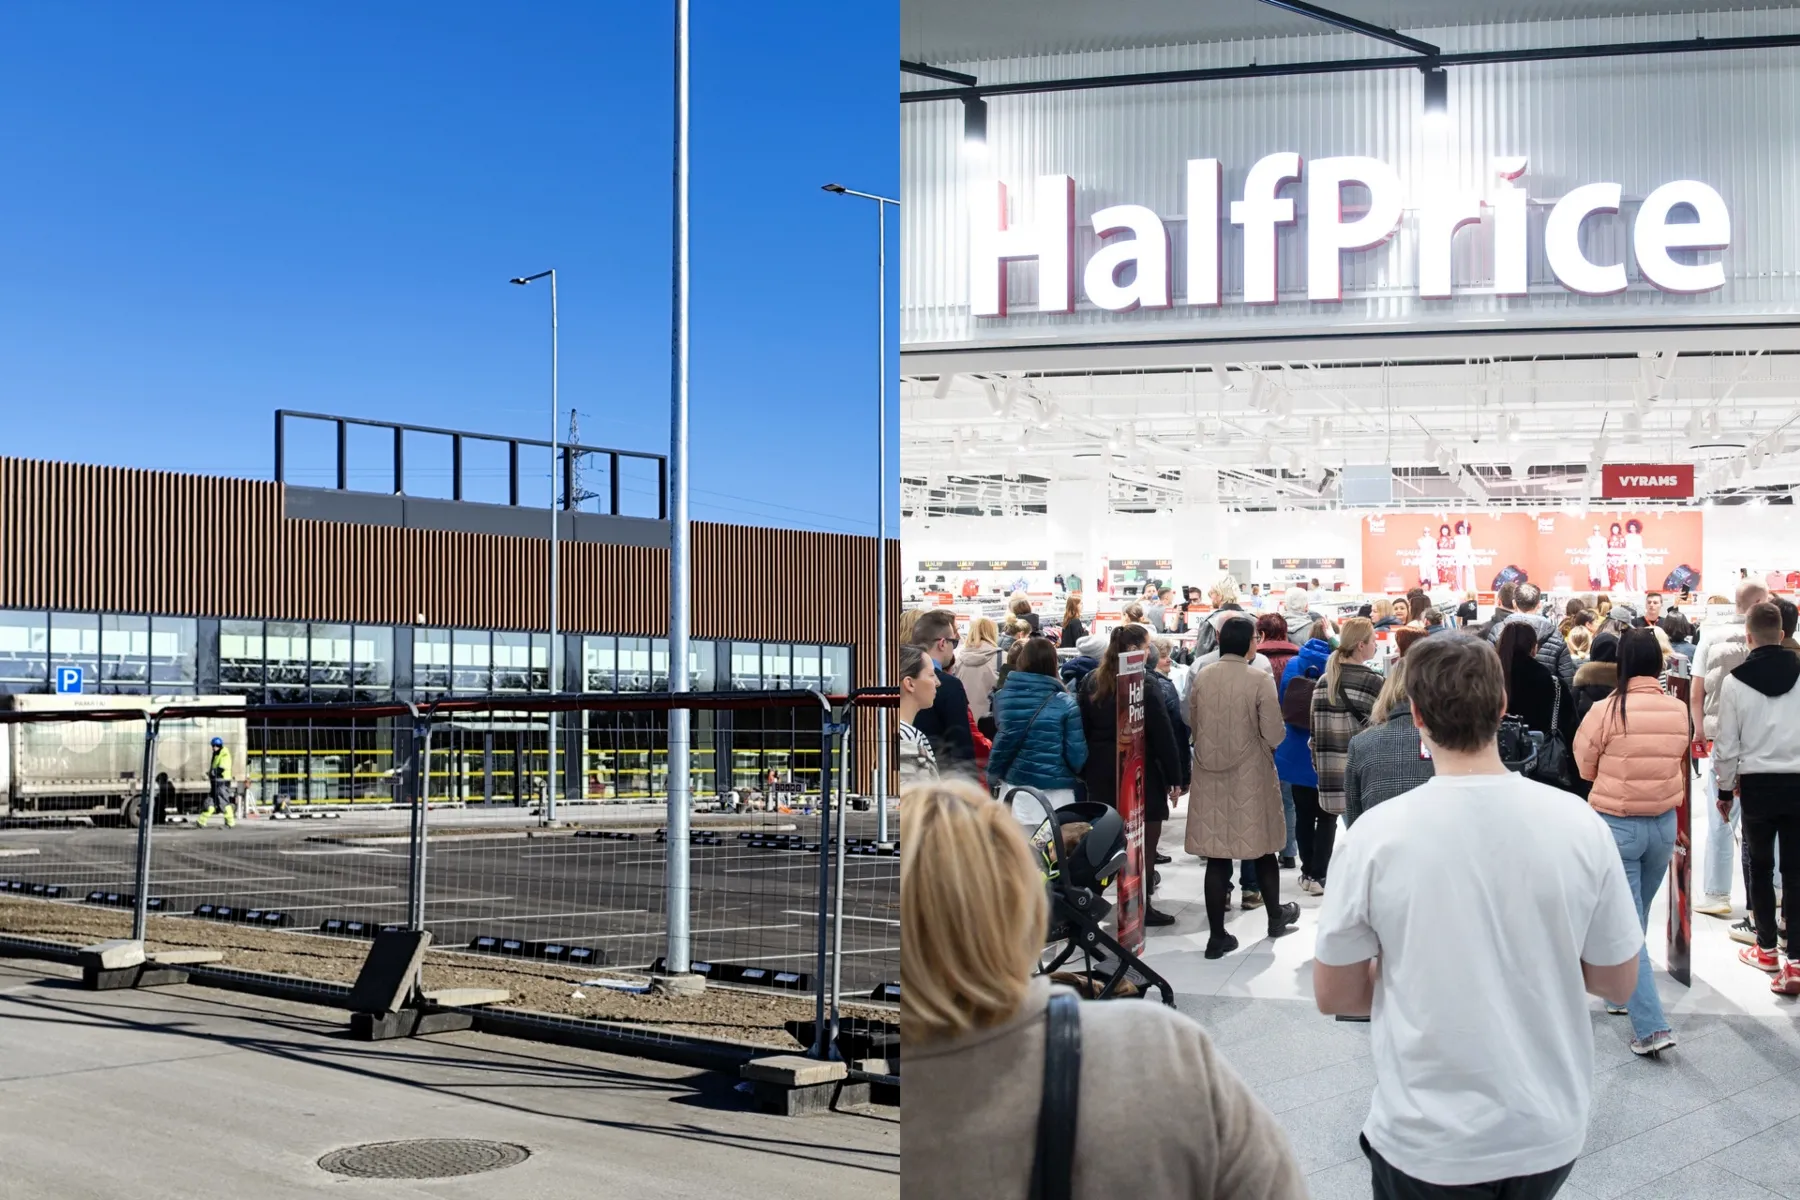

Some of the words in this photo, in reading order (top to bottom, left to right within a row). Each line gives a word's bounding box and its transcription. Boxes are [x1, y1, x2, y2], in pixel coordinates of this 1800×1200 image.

[970, 151, 1732, 318] HalfPrice
[1618, 475, 1678, 487] VYRAMS
[63, 669, 78, 691] P
